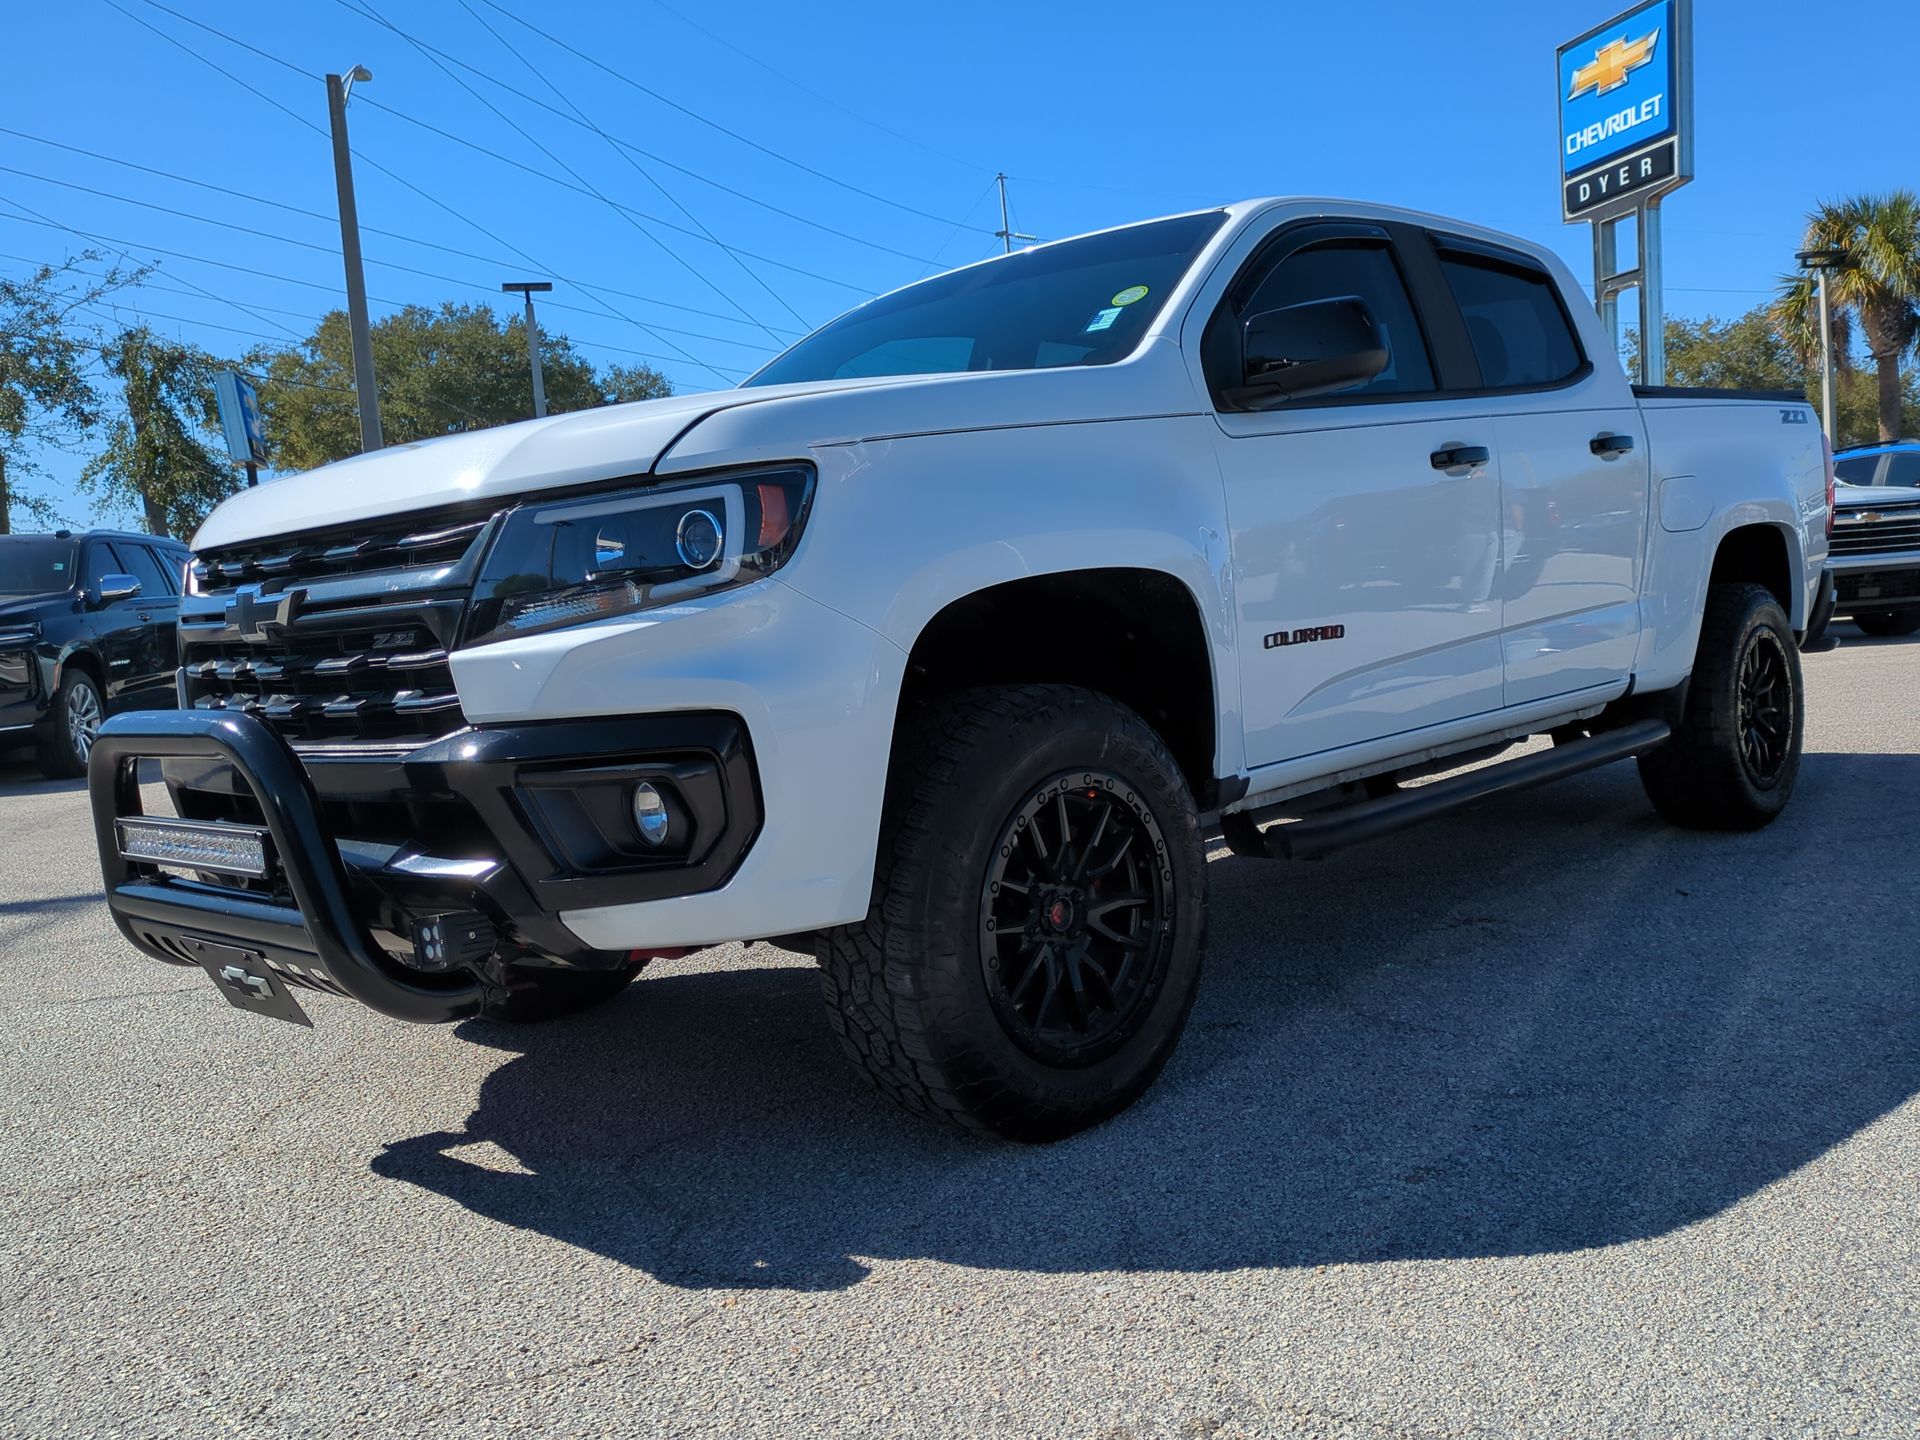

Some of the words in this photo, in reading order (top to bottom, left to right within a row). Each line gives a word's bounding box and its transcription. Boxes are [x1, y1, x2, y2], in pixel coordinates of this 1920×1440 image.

[1566, 93, 1663, 155] CHEVROLET
[1579, 157, 1652, 202] DYER
[1264, 624, 1345, 649] COLORADO
